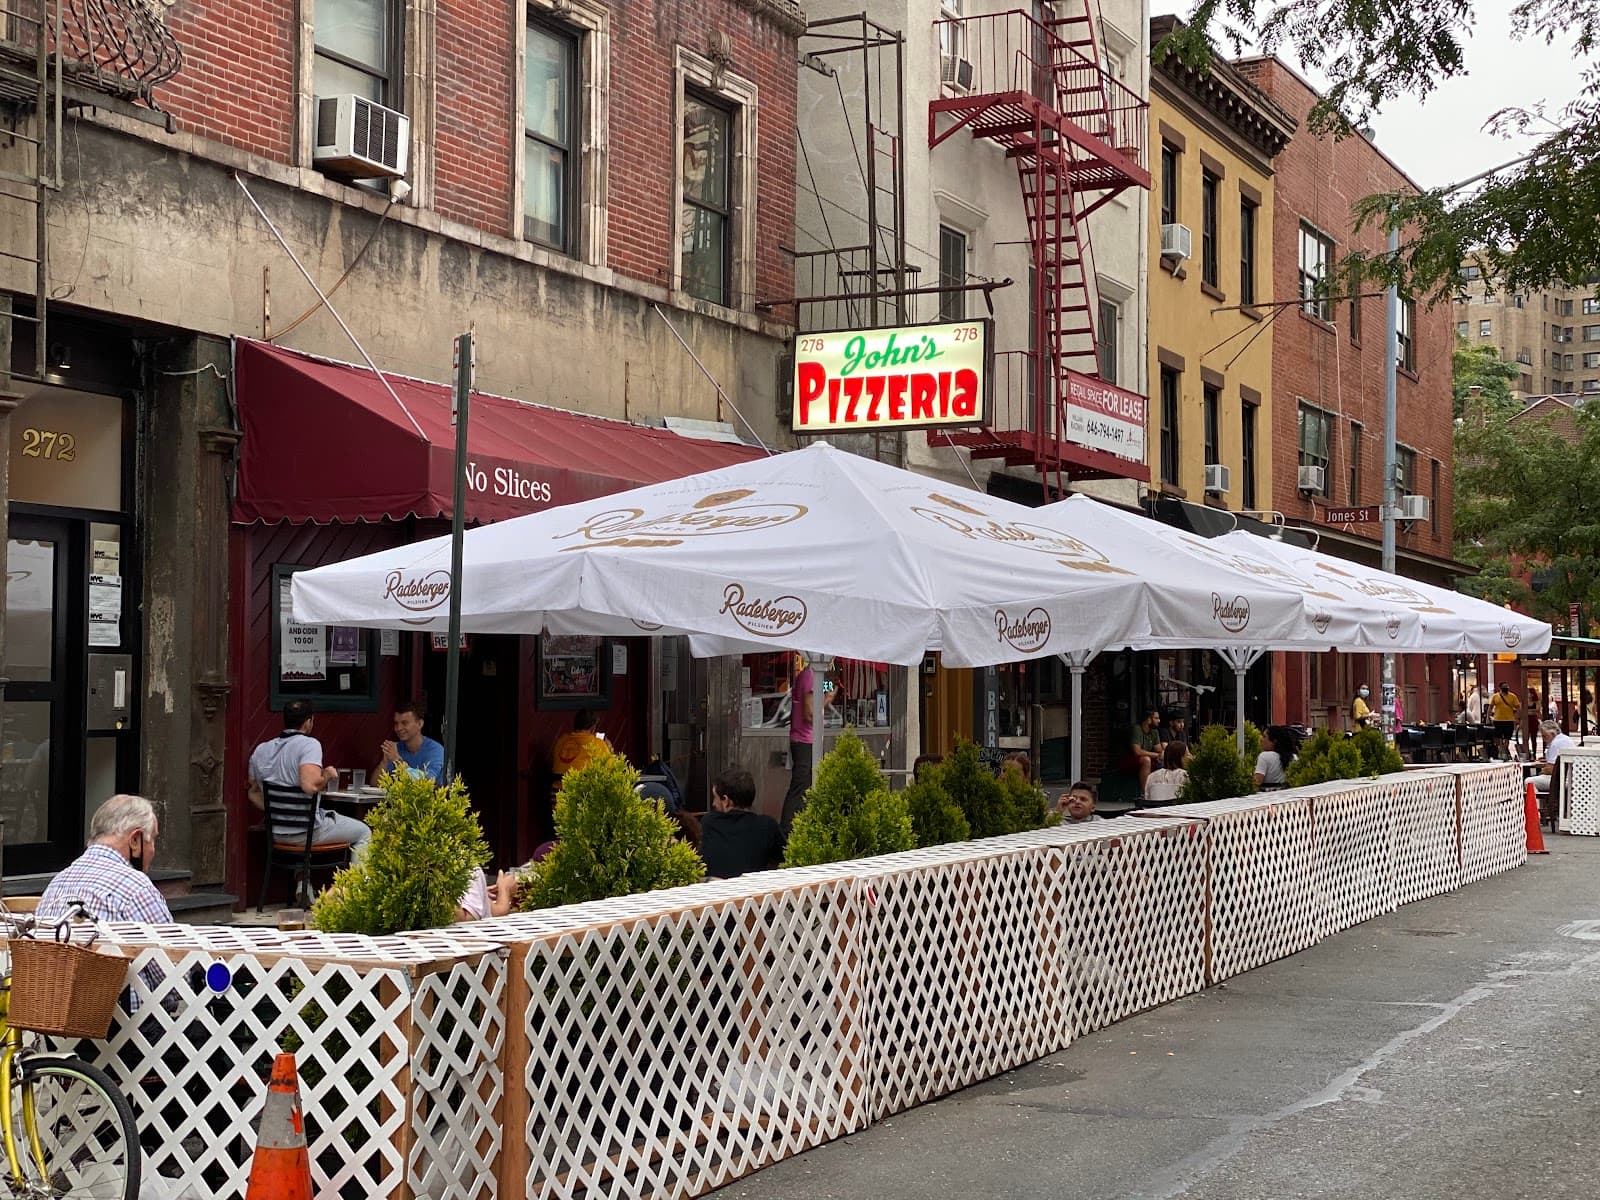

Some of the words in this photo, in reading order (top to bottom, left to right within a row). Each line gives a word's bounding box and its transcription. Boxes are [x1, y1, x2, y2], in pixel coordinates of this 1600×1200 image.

[801, 338, 824, 353] 278
[953, 327, 978, 343] 278
[841, 333, 945, 376] John's
[1070, 382, 1086, 400] RETAIL
[1087, 388, 1103, 405] SPACE
[1102, 389, 1119, 413] FOR
[1120, 395, 1143, 421] LEASE
[22, 428, 76, 462] 272
[465, 462, 488, 492] No
[493, 467, 552, 503] Slices
[1326, 511, 1356, 522] Jones
[1359, 509, 1369, 521] St
[383, 570, 449, 602] Radeberger
[719, 583, 803, 630] Radeberger
[289, 627, 302, 635] AND
[747, 621, 774, 630] PILSNER
[994, 609, 1049, 643] Radeberger
[878, 698, 885, 713] A
